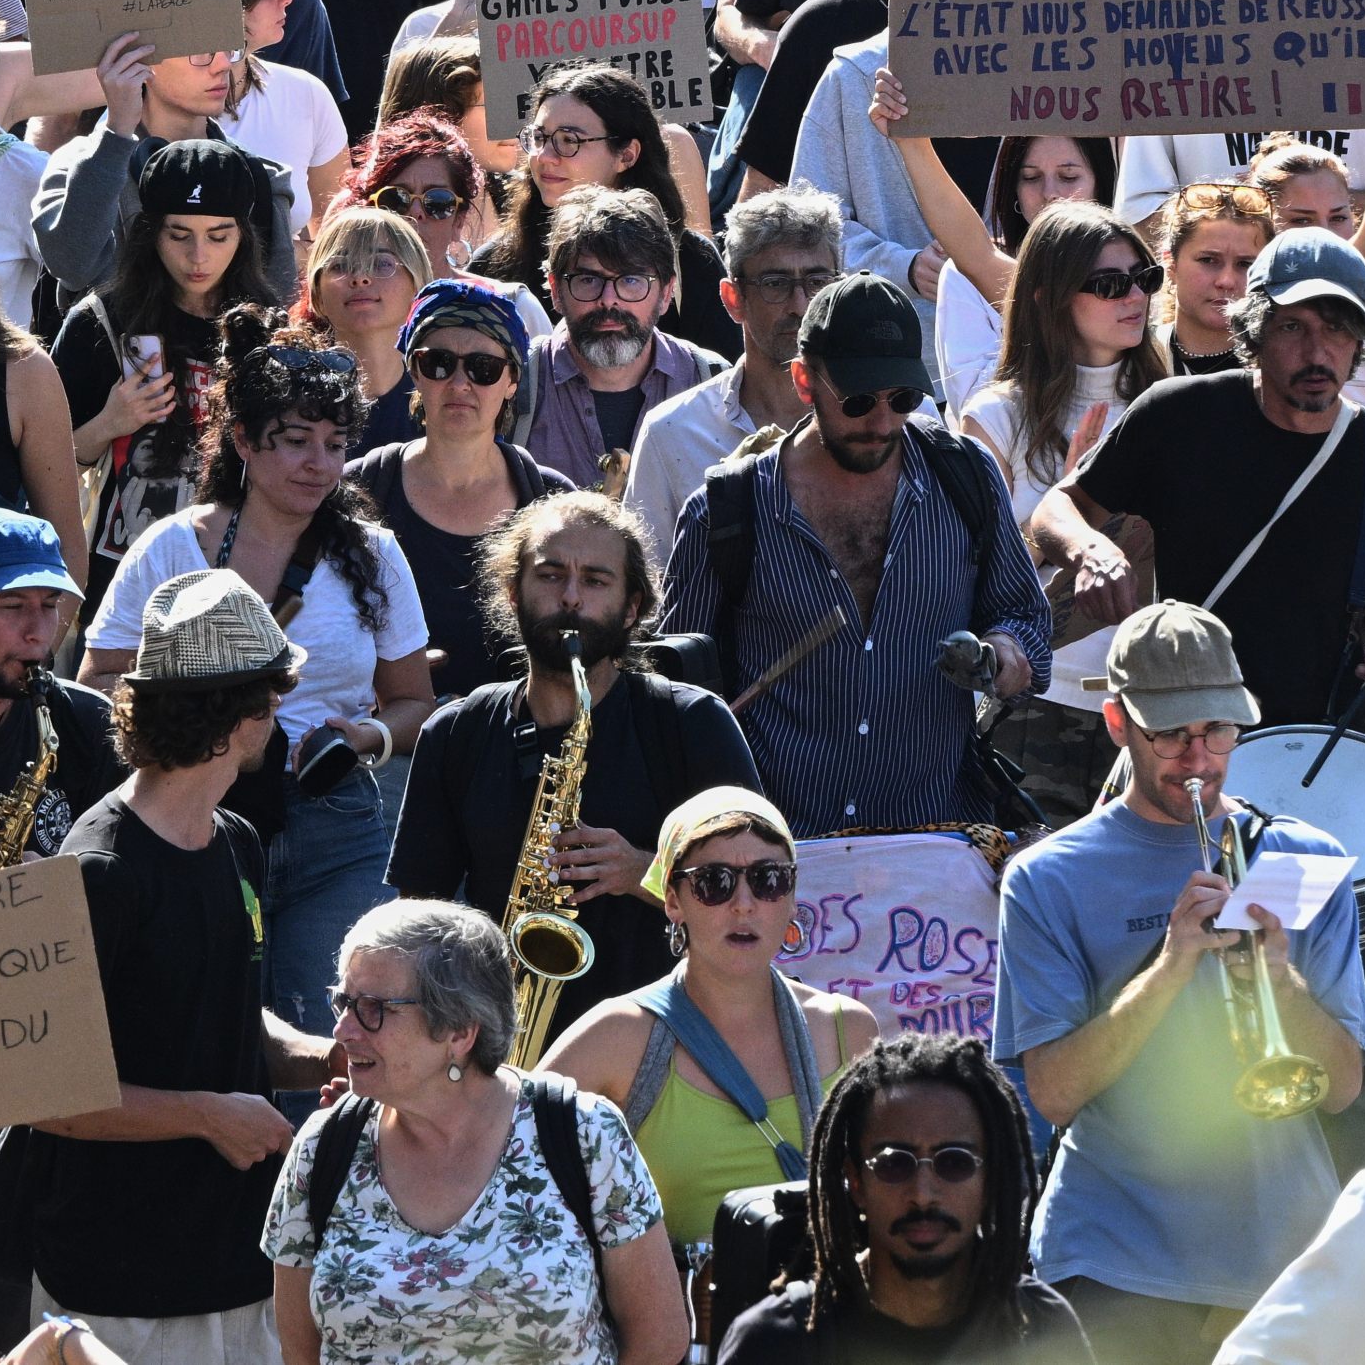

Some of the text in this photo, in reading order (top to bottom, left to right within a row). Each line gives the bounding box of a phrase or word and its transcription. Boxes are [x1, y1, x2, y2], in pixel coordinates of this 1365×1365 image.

[495, 6, 678, 63] PARCOURSUP
[896, 0, 1015, 40] L'ÉTAT
[1022, 0, 1088, 35] NOUS
[934, 41, 1009, 76] AVEC
[1031, 37, 1098, 73] LES
[1010, 84, 1102, 122] NOUS
[773, 892, 864, 965] DES
[888, 981, 943, 1009] DES
[0, 1009, 50, 1052] DU
